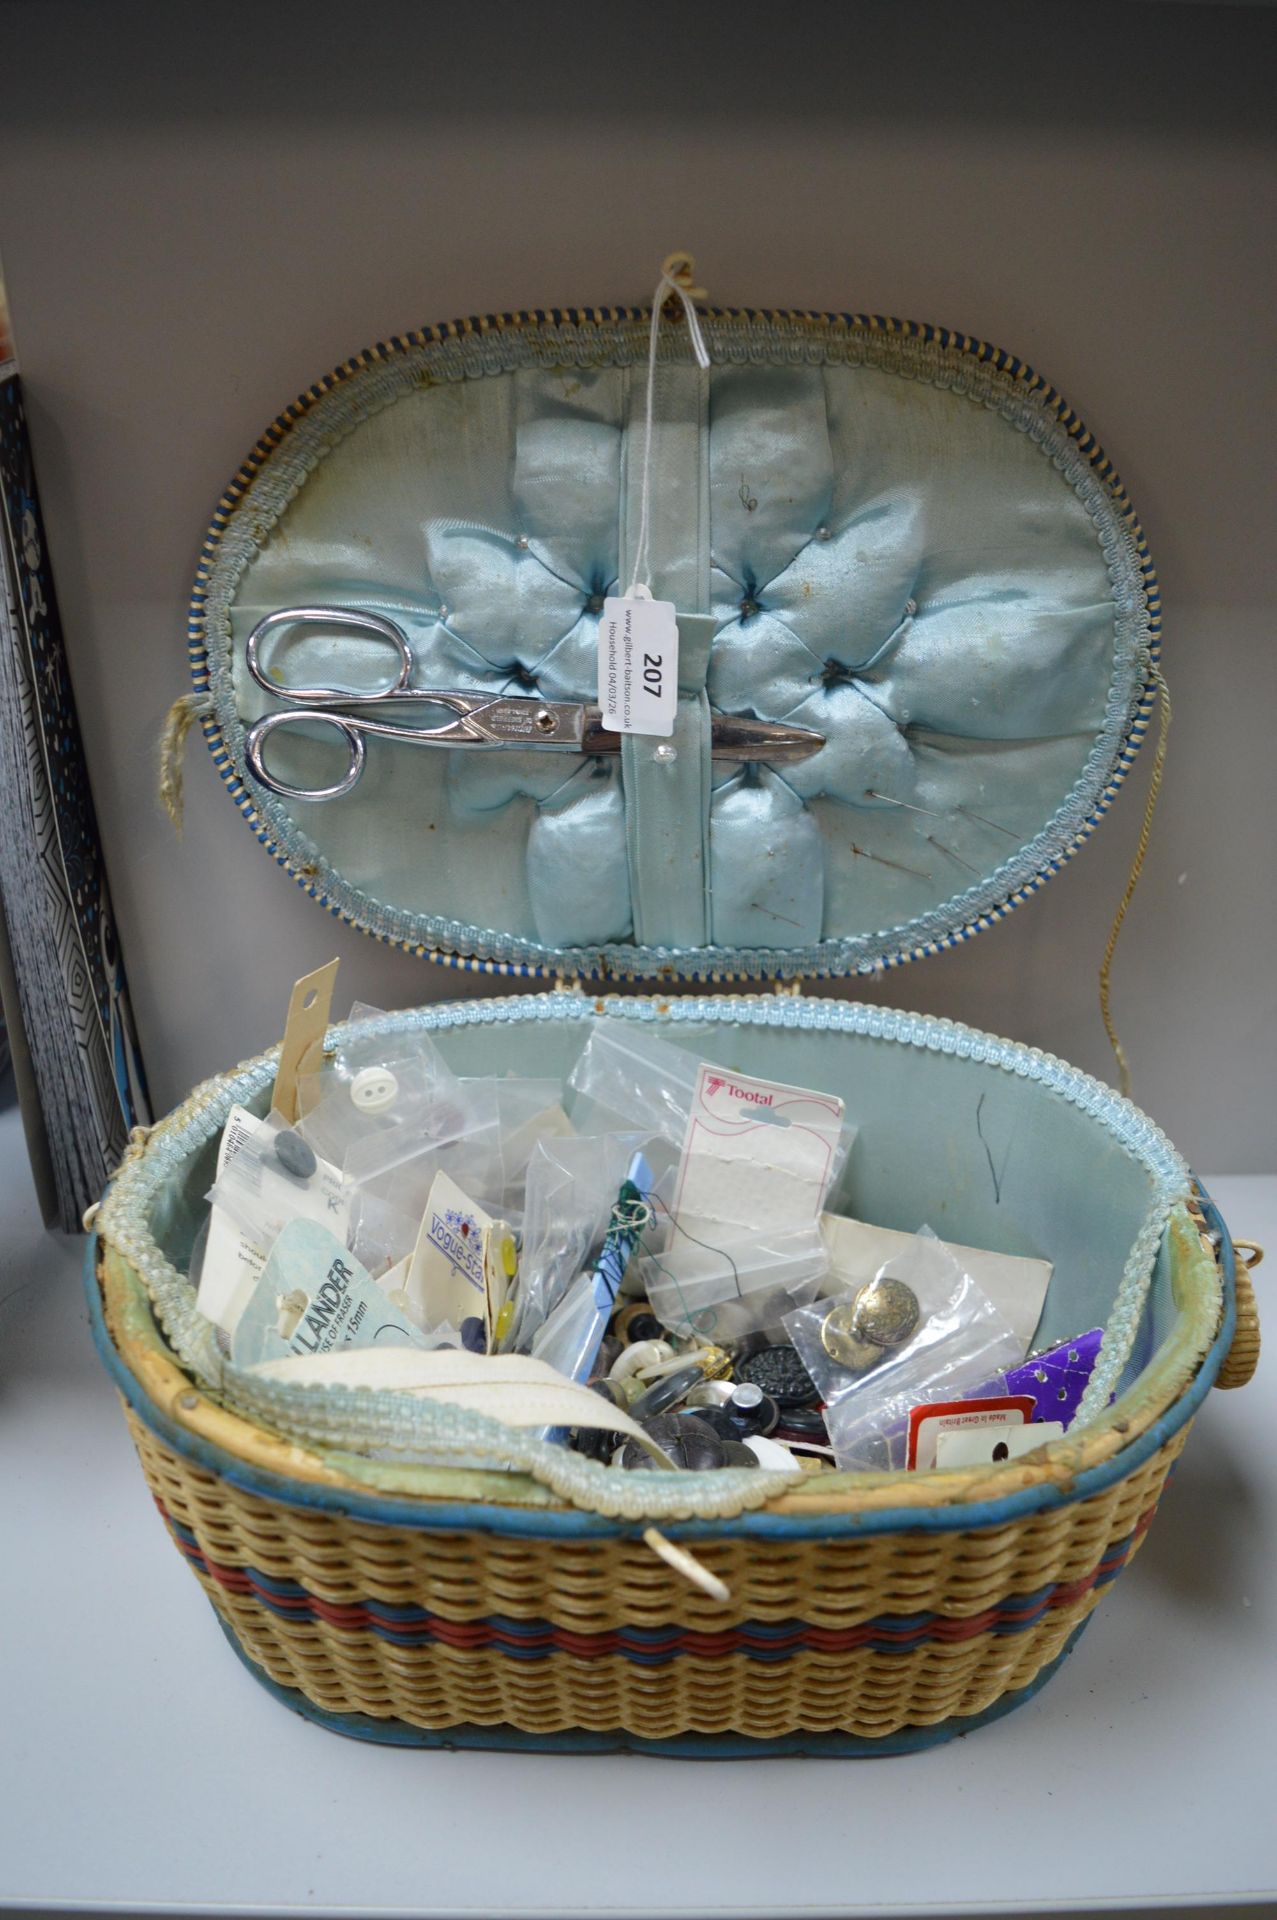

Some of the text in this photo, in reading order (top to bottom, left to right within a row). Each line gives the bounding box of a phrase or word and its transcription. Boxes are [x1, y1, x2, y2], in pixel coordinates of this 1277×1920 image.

[608, 621, 617, 715] Household 04/03/26
[624, 609, 633, 729] www.gilbert-baitson.co.uk
[643, 653, 662, 698] 207
[726, 1083, 774, 1106] Tootal
[290, 1258, 354, 1355] LANDER
[328, 1322, 338, 1340] OF
[334, 1294, 353, 1327] FRASER
[346, 1301, 368, 1335] 15mm
[939, 1417, 961, 1427] Britain
[961, 1416, 979, 1424] Great
[988, 1413, 1007, 1422] Made
